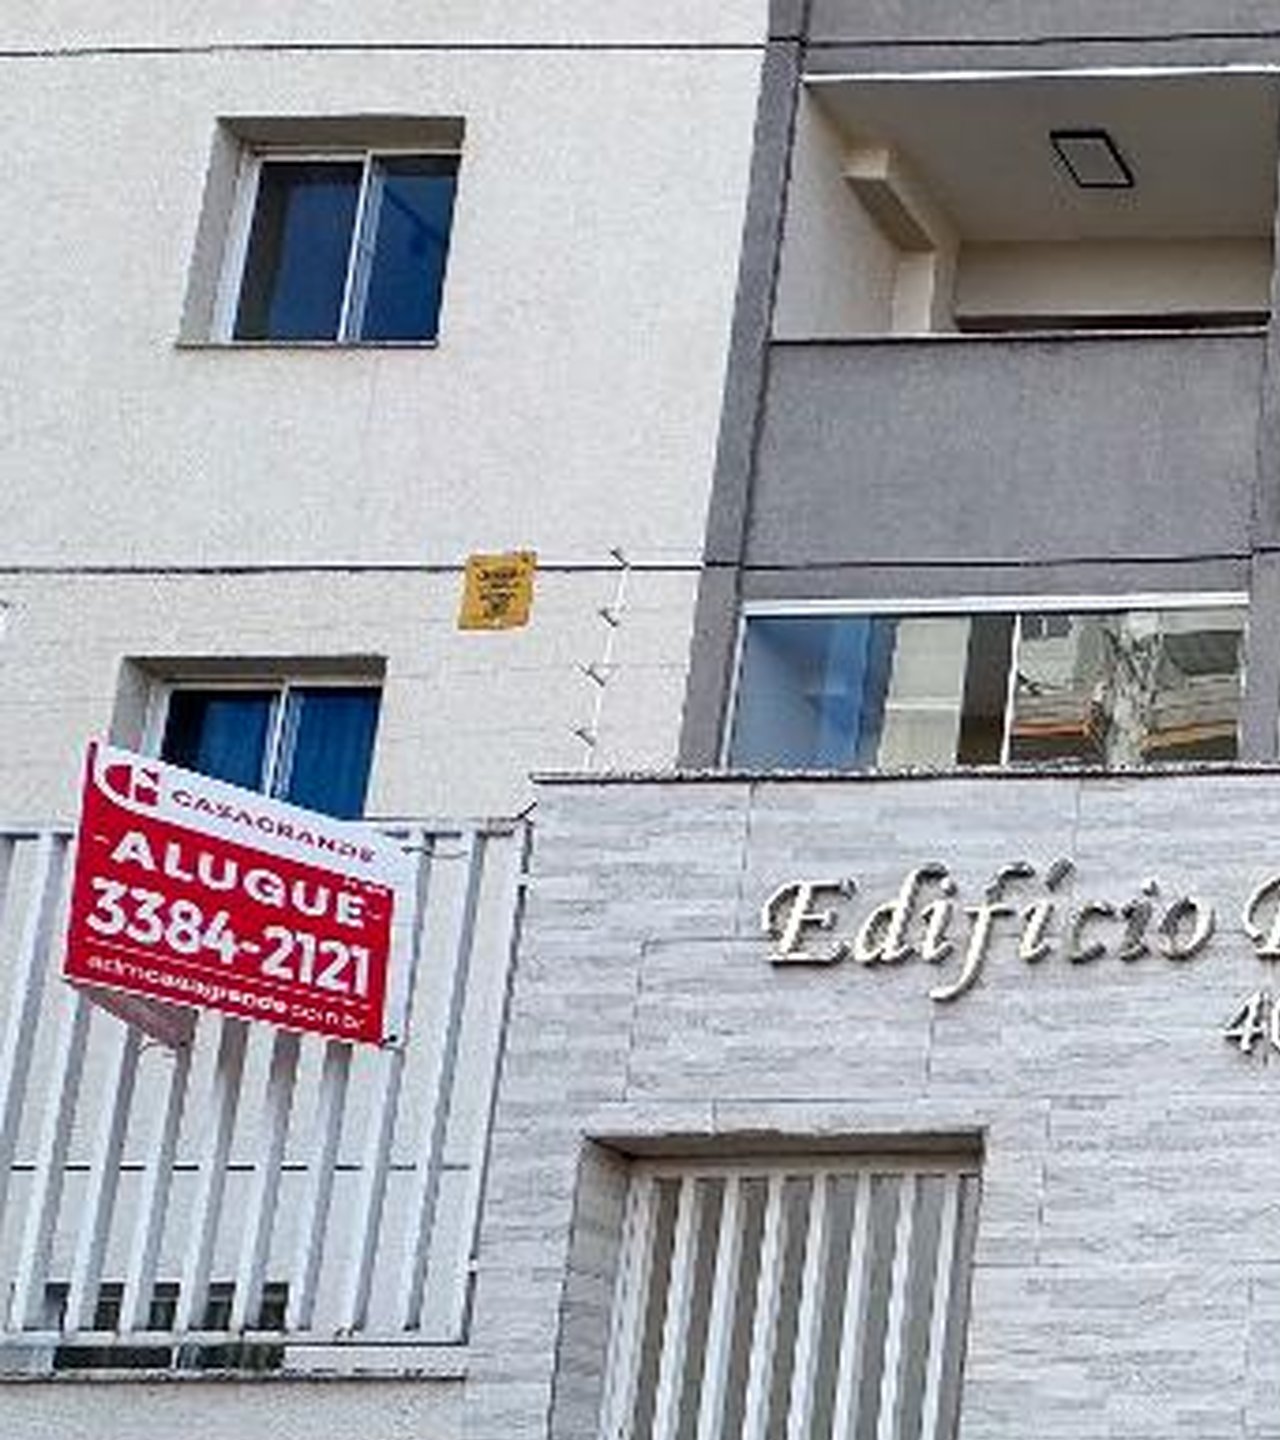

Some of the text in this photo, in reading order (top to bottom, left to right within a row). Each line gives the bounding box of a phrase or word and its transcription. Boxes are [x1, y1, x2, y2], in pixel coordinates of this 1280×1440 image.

[111, 831, 367, 928] ALUGUE
[171, 788, 377, 864] CASAGRANDE
[86, 876, 370, 997] 3384-2121
[761, 857, 1215, 1001] Edifício
